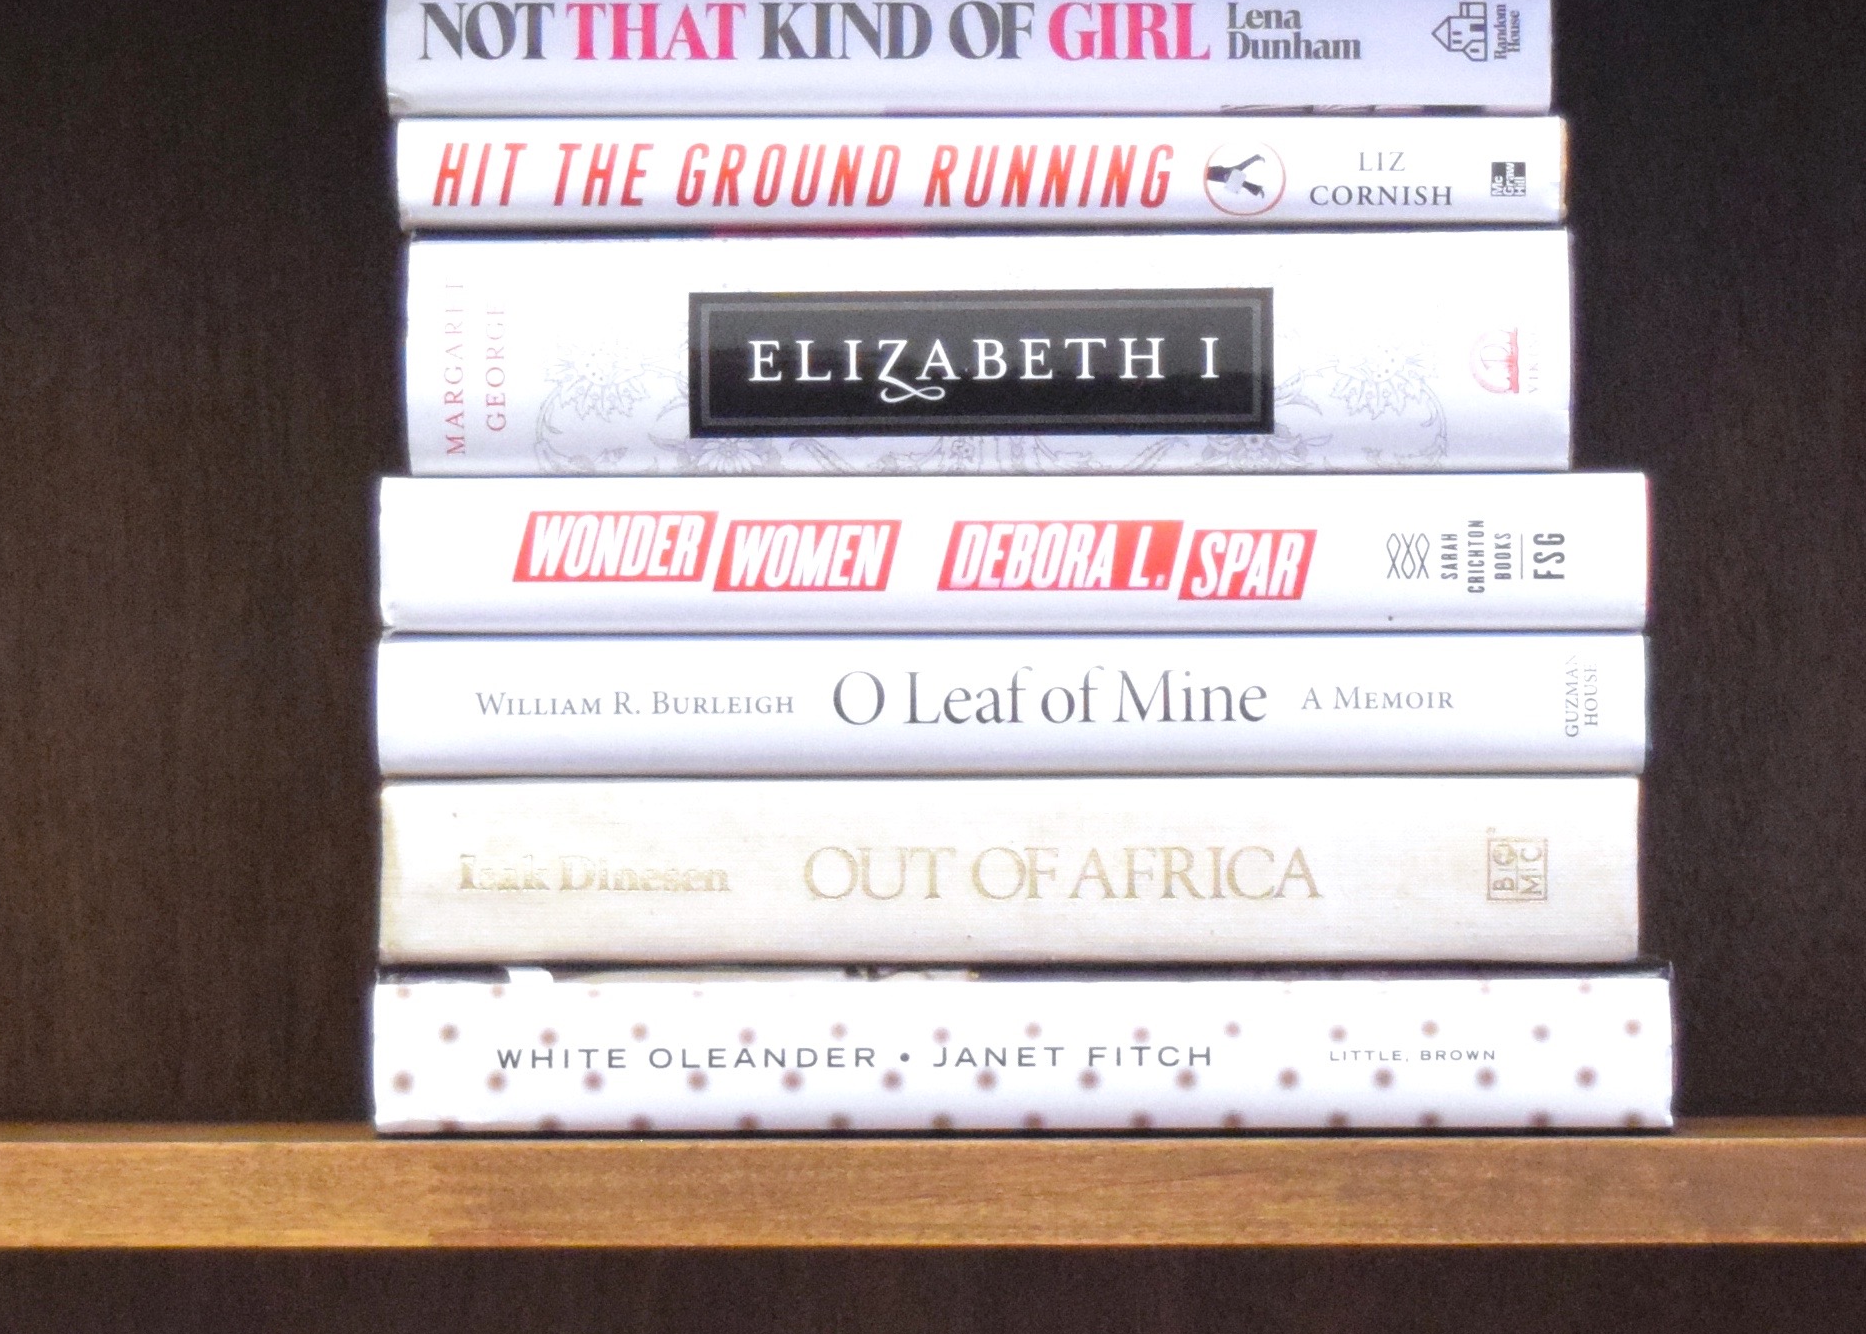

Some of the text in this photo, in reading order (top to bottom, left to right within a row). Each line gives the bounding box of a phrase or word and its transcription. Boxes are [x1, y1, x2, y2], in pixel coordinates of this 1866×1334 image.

[419, 0, 1211, 61] NOT THAT KIND OF GIRL
[1227, 2, 1302, 30] Lena
[1493, 3, 1507, 60] Random
[1507, 9, 1521, 53] House
[1227, 31, 1362, 60] Dunham
[432, 142, 1174, 209] HIT THE GROUND RUNNING
[1358, 151, 1406, 172] LIZ
[1491, 174, 1504, 196] Mc
[1503, 162, 1515, 196] Graw
[1309, 185, 1453, 207] CORNISH
[1514, 176, 1526, 196] Hill
[485, 300, 507, 433] GEORGE
[748, 336, 1220, 403] ELIZABETH I
[529, 514, 890, 588] WONDER WOMEN
[949, 522, 1306, 598] DEBORA L. SPAR
[1440, 533, 1459, 580] SARAH
[1467, 520, 1486, 594] CRICHTON
[1493, 532, 1512, 580] BOOKS
[1532, 533, 1566, 580] FSG
[475, 691, 794, 716] WILLIAM R. BURLEIGH
[833, 665, 1267, 725] O Leaf of Mine
[1300, 686, 1454, 710] A MEMOIR
[1564, 654, 1580, 738] GUZMAN
[1583, 661, 1599, 727] HOUSE
[557, 853, 733, 894] Dinesen
[803, 845, 1324, 902] OUT OF AFRICA
[496, 1045, 1211, 1070] WHITE OLEANDER JANET FITCH
[1329, 1049, 1495, 1065] LITTLE, BROWN
